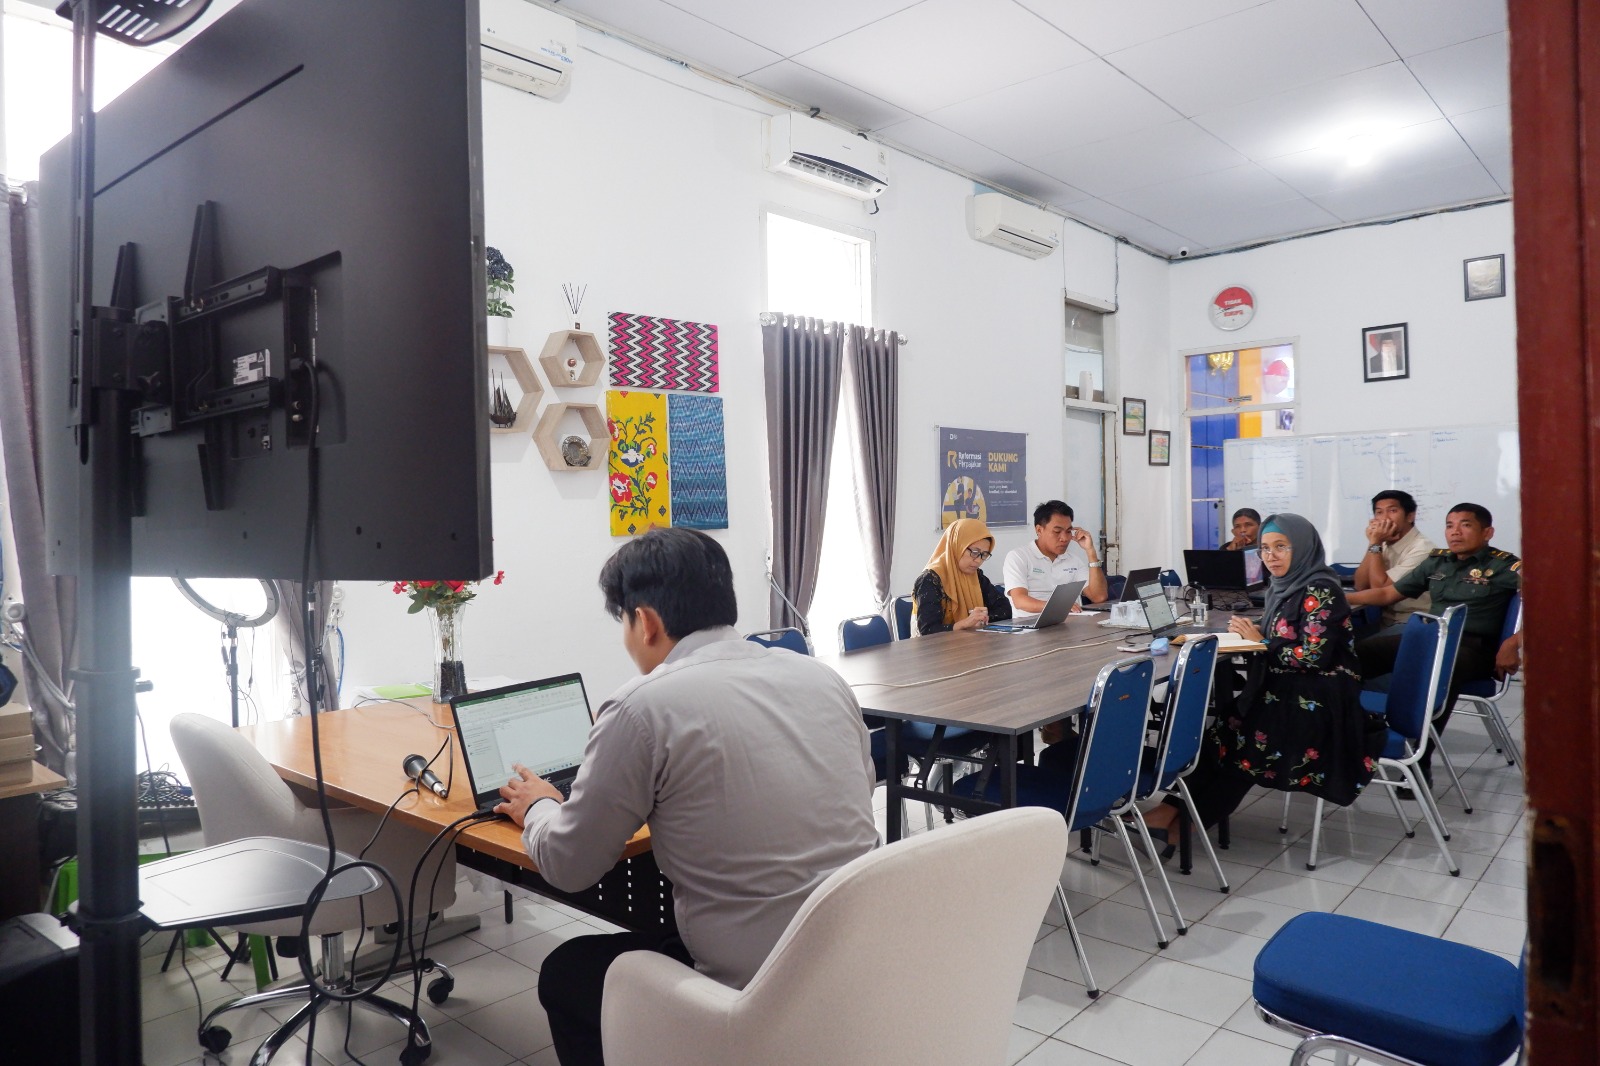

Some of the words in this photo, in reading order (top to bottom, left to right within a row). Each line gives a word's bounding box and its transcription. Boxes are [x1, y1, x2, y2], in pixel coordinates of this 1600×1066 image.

[958, 452, 982, 460] Reformasi
[988, 452, 1018, 462] DUKUNG
[958, 459, 982, 469] Perpajakan
[988, 463, 1007, 473] KAMI
